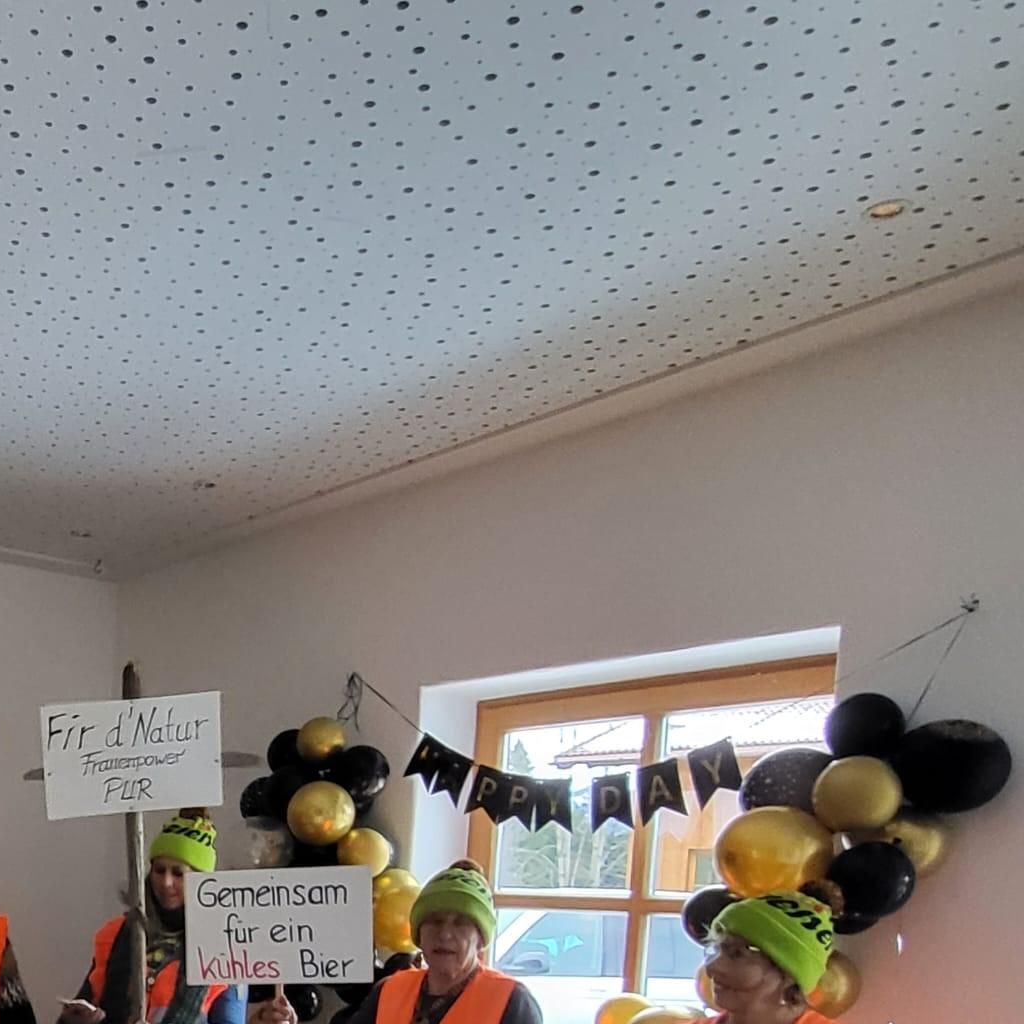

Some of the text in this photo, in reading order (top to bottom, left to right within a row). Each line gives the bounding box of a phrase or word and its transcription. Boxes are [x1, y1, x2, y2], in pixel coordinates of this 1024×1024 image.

[105, 706, 209, 749] d'Natur
[80, 748, 187, 777] Frauenpower
[103, 776, 154, 804] PUR
[598, 750, 724, 815] DAY
[196, 875, 348, 908] Gemeinsam
[223, 912, 314, 947] für ein
[197, 946, 355, 980] kühles Bier
